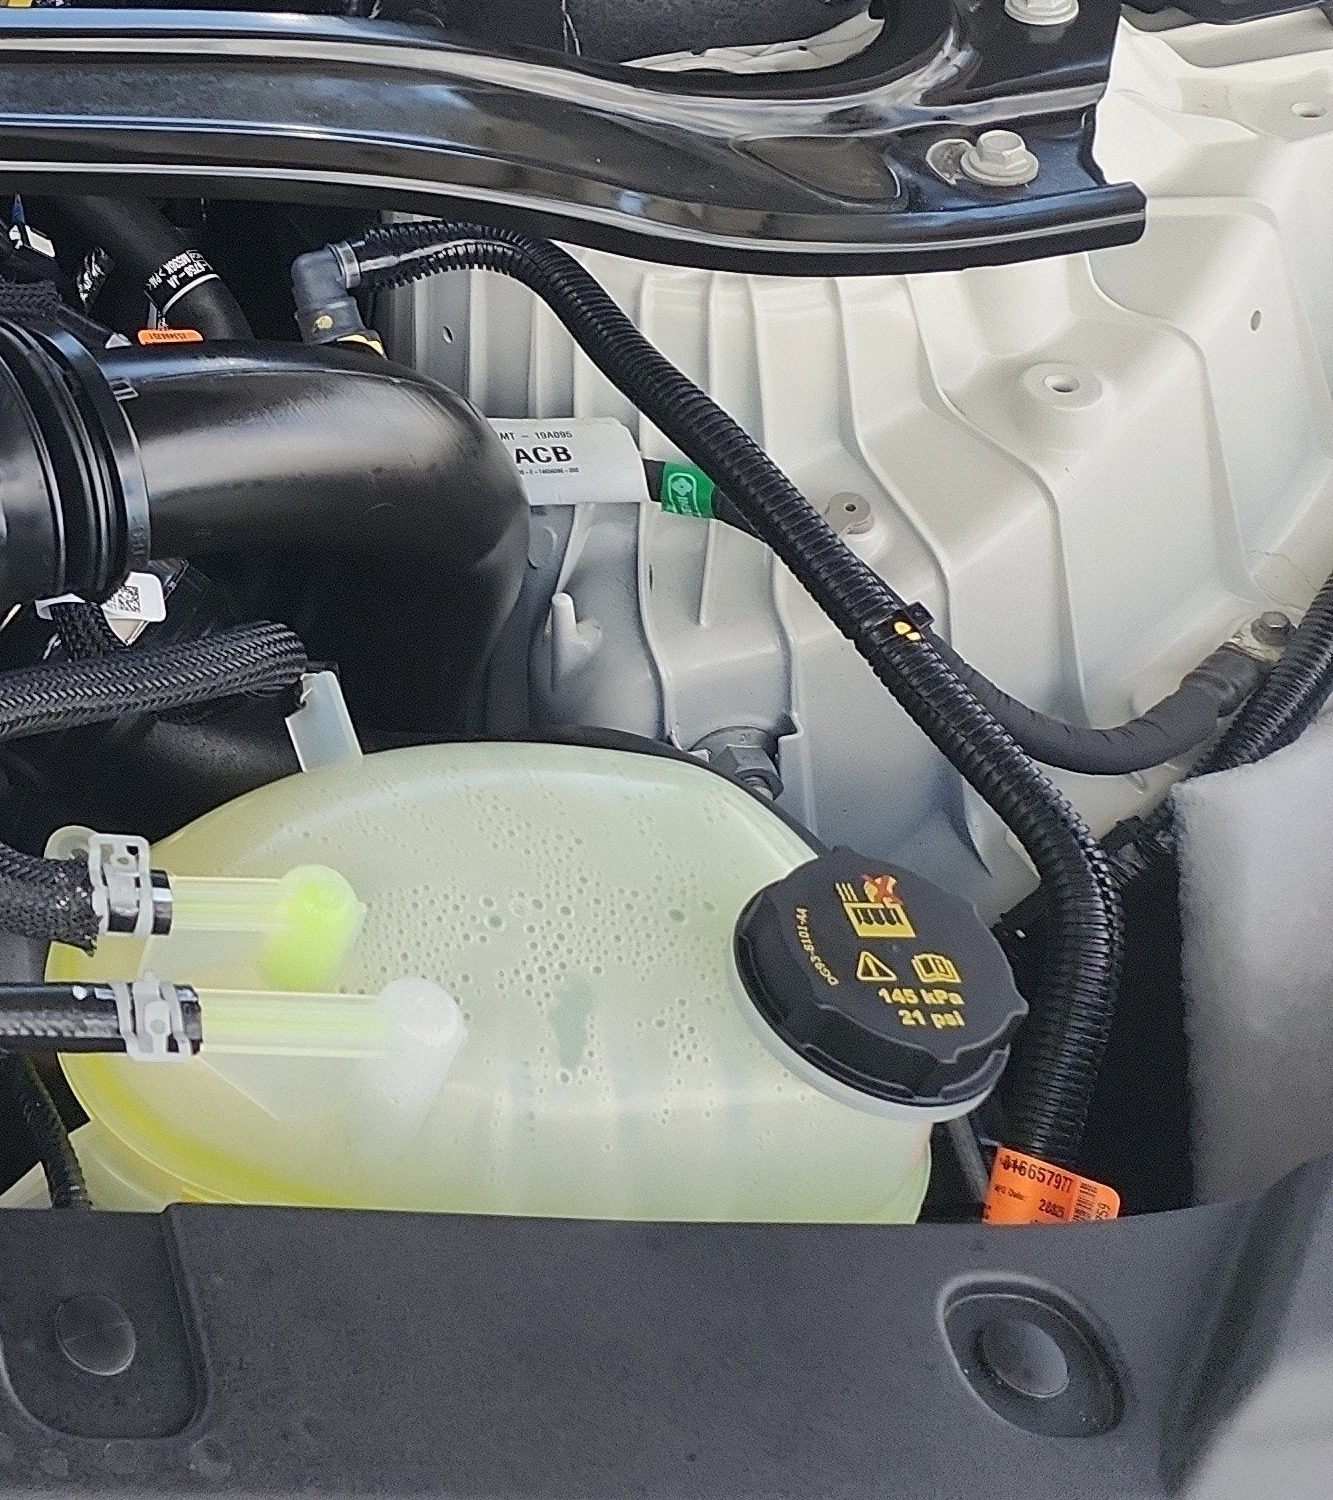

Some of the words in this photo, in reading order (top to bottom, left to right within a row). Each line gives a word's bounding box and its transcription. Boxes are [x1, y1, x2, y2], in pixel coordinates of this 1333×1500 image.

[534, 430, 573, 440] 19A095
[515, 445, 572, 464] ACB
[878, 988, 919, 1005] 145
[922, 988, 965, 1006] kPa
[898, 1010, 927, 1027] 21
[931, 1010, 965, 1029] psi
